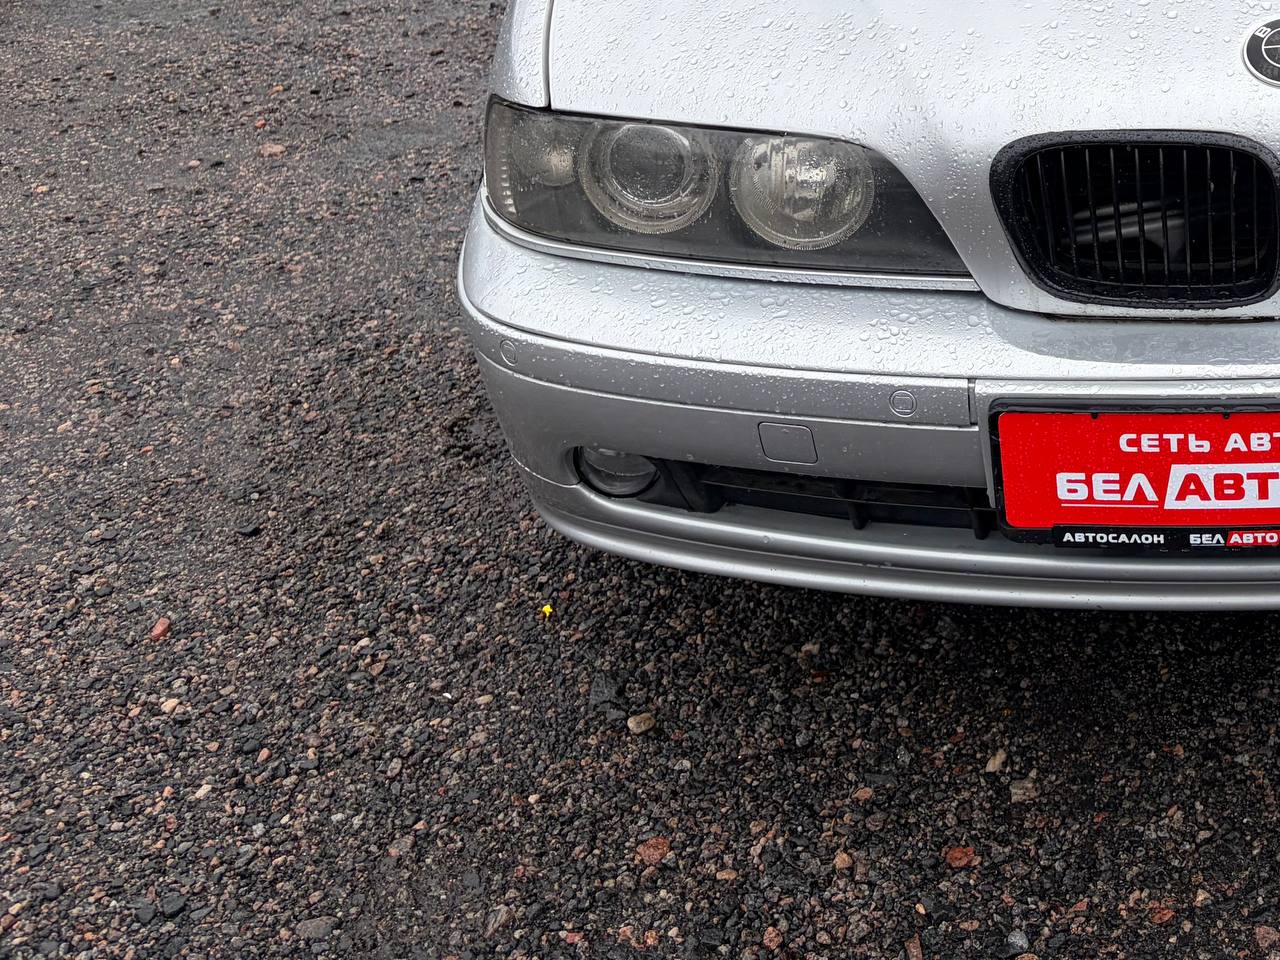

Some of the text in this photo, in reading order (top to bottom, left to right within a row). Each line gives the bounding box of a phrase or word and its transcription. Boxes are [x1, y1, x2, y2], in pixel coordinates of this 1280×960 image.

[1119, 433, 1211, 453] СЕТЬ
[1056, 472, 1159, 501] БЕЛ
[1063, 532, 1165, 544] АВТОСАЛОН
[1189, 533, 1225, 544] БЕЛ
[1229, 532, 1279, 544] АВТО
